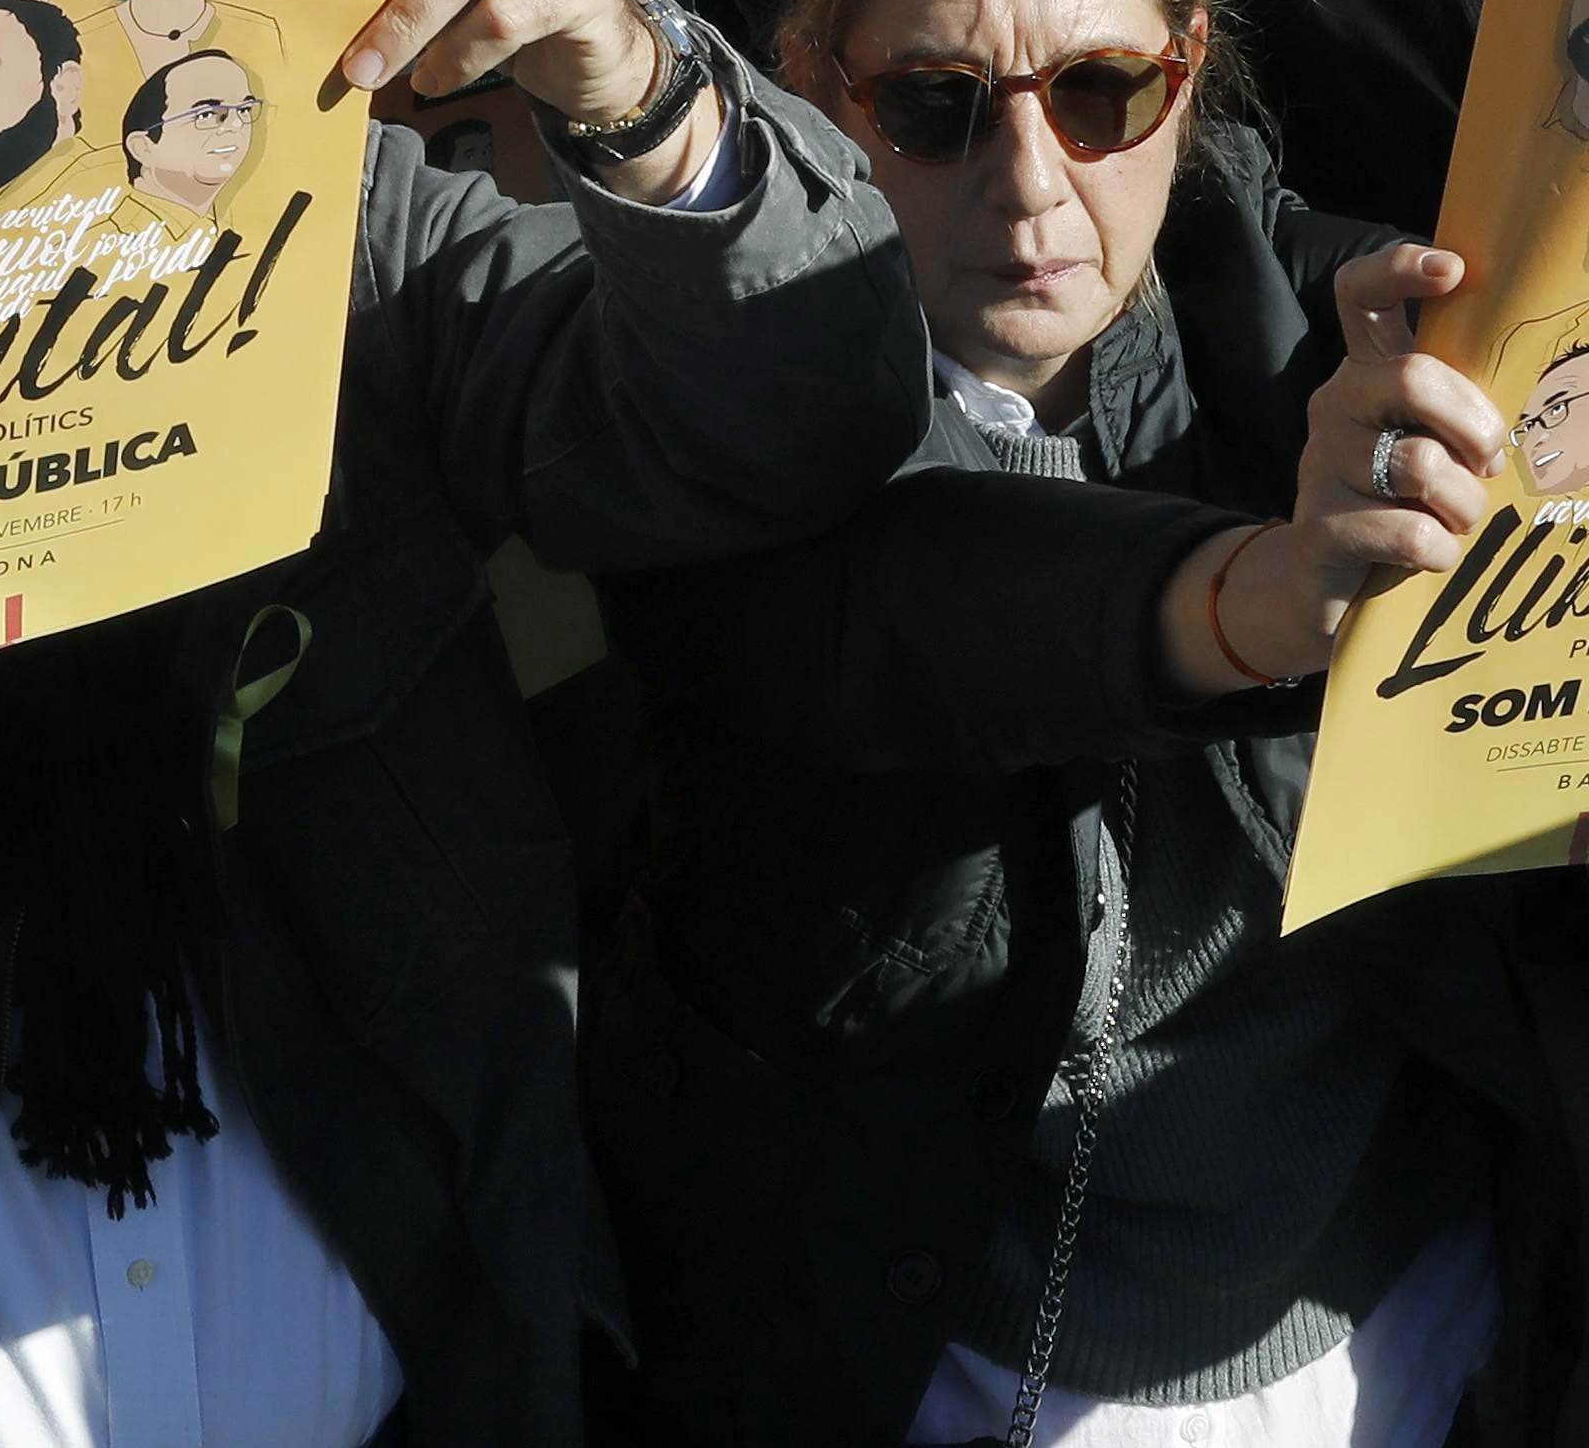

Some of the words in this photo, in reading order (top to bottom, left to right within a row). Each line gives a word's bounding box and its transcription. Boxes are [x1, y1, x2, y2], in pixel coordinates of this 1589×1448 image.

[90, 222, 166, 261] jordi
[94, 226, 218, 299] jordi
[101, 496, 125, 514] 17
[1445, 686, 1578, 733] SOM
